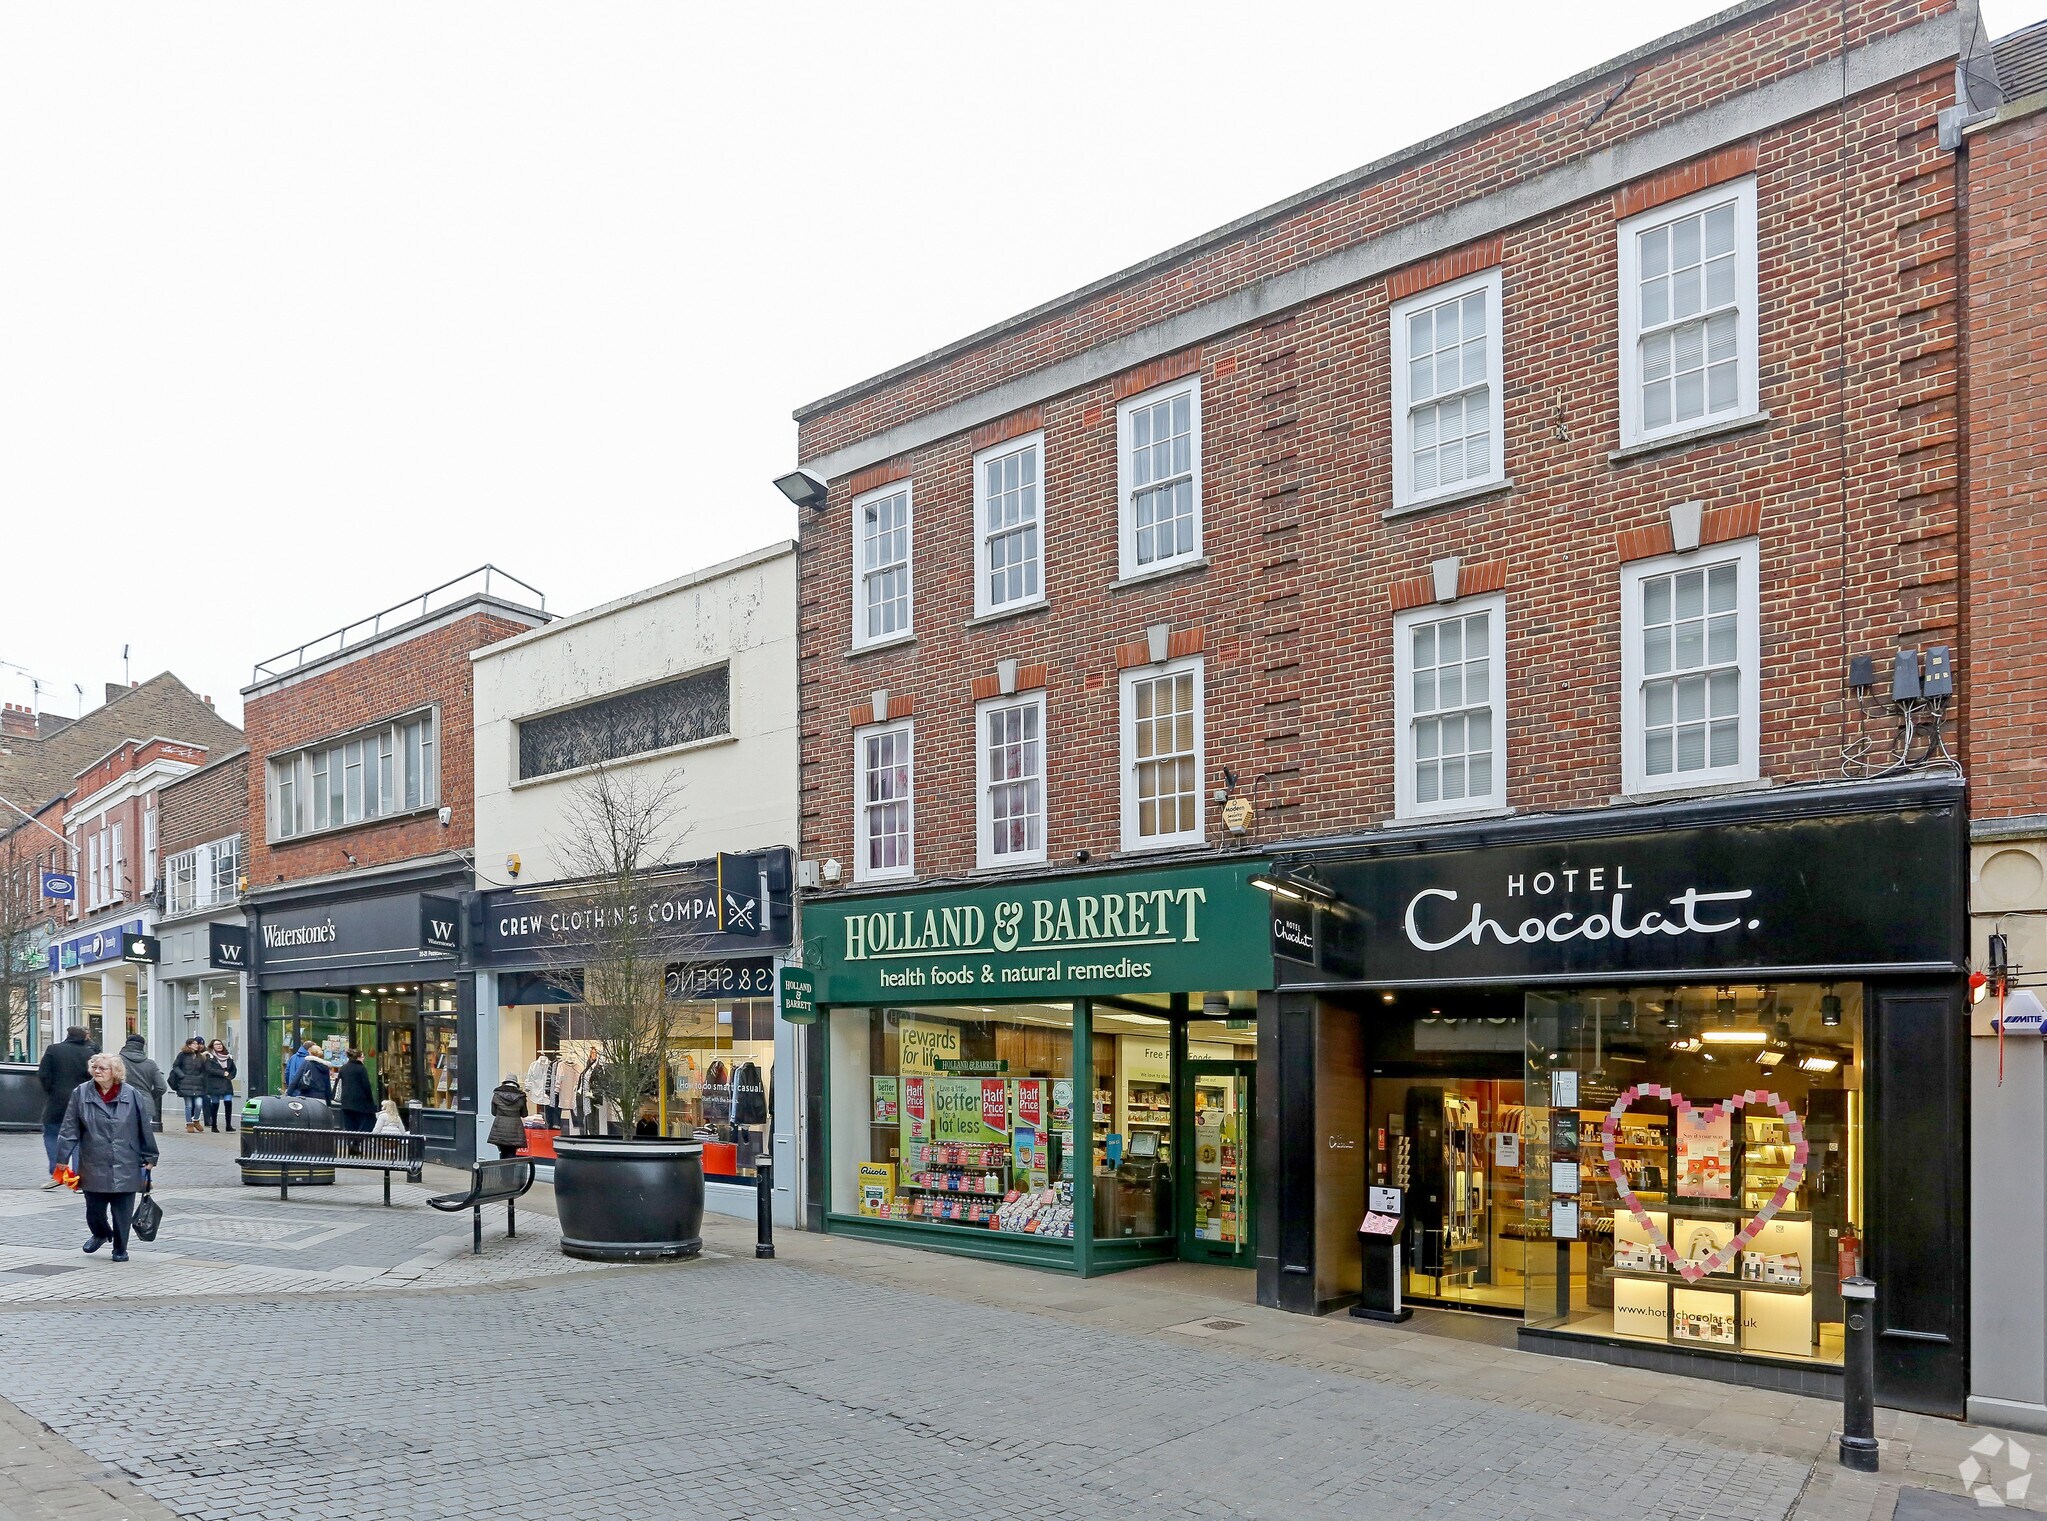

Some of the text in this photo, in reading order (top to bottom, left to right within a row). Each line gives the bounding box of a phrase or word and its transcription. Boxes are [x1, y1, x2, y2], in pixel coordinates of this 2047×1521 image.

[1508, 865, 1633, 897] HOTEL
[500, 898, 717, 937] CREW CLOTHING COMPA
[844, 887, 1207, 961] HOLLAND & BARRETT
[1404, 887, 1761, 952] Chocolat.
[262, 918, 336, 949] Waterstone's
[430, 919, 454, 941] W
[220, 943, 242, 960] W
[880, 957, 1152, 988] health foods & natural remedies
[785, 980, 812, 993] HOLLAND
[795, 991, 802, 999] &
[785, 999, 812, 1012] BARRETT
[902, 1028, 956, 1050] rewards
[902, 1045, 919, 1065] for
[1145, 1048, 1163, 1060] Free
[942, 1060, 968, 1070] HOLLAND
[975, 1060, 1001, 1070] BARRETT
[703, 1080, 712, 1090] do
[737, 1081, 764, 1093] casual.
[906, 1085, 923, 1097] Half
[1019, 1087, 1039, 1100] Half
[906, 1096, 924, 1106] Price
[936, 1091, 980, 1112] better
[983, 1088, 1004, 1102] Half
[983, 1102, 1004, 1114] Price
[1019, 1099, 1039, 1110] Price
[940, 1117, 980, 1134] lot less
[860, 1166, 888, 1176] Ricola
[1618, 1305, 1757, 1328] www.hotelchocolat.co.uk
